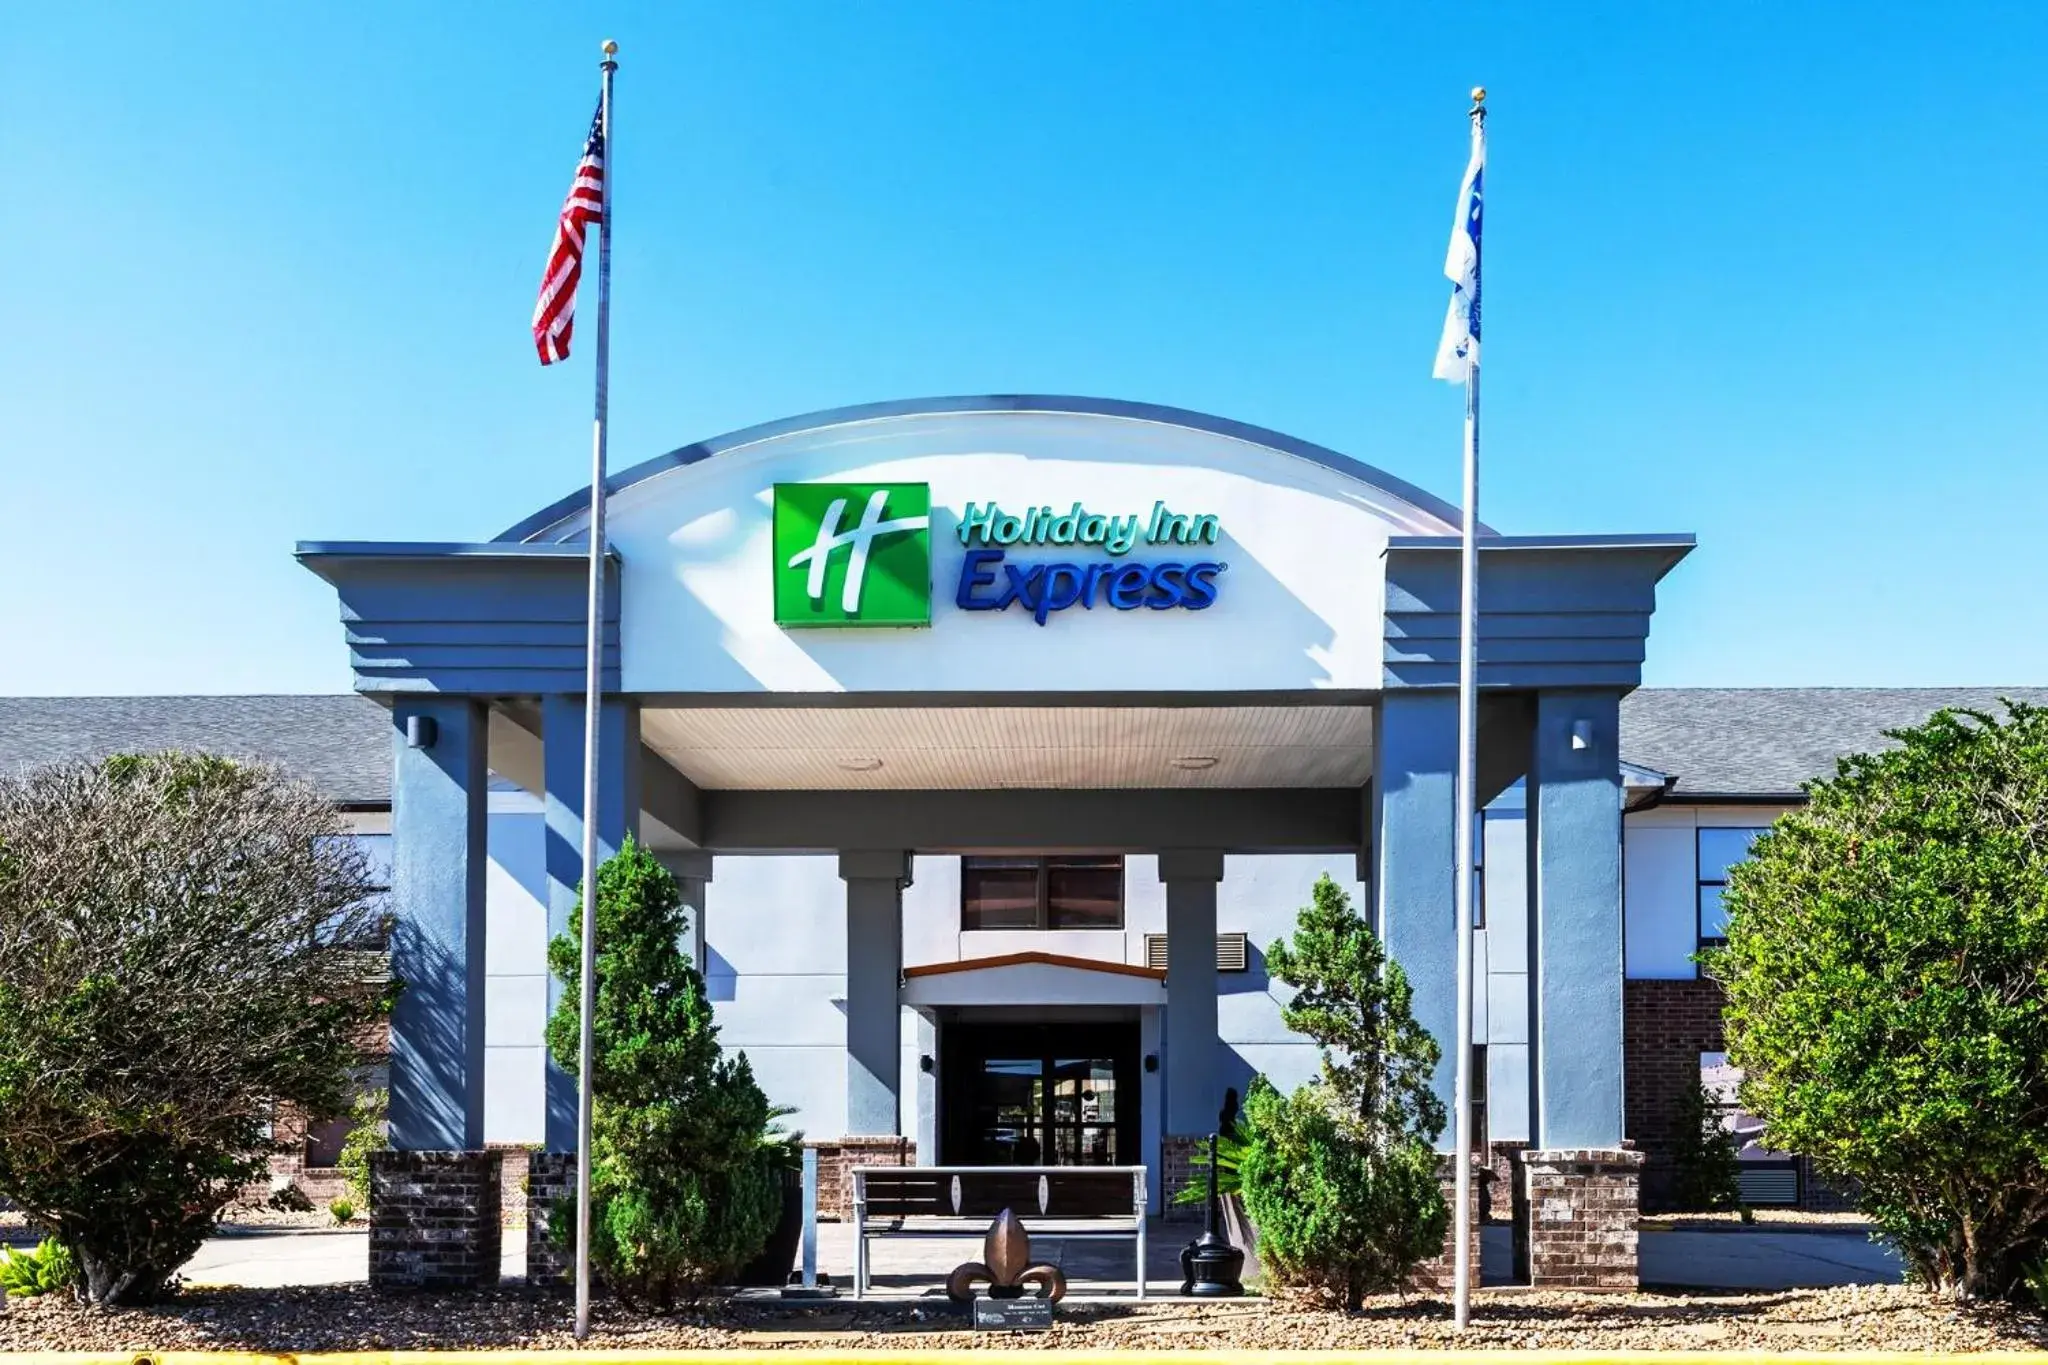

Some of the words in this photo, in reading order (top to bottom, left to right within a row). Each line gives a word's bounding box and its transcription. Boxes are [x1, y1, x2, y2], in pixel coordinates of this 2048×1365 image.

[957, 501, 1138, 556] Holiday
[1146, 500, 1220, 546] Inn
[954, 549, 1221, 626] Express
